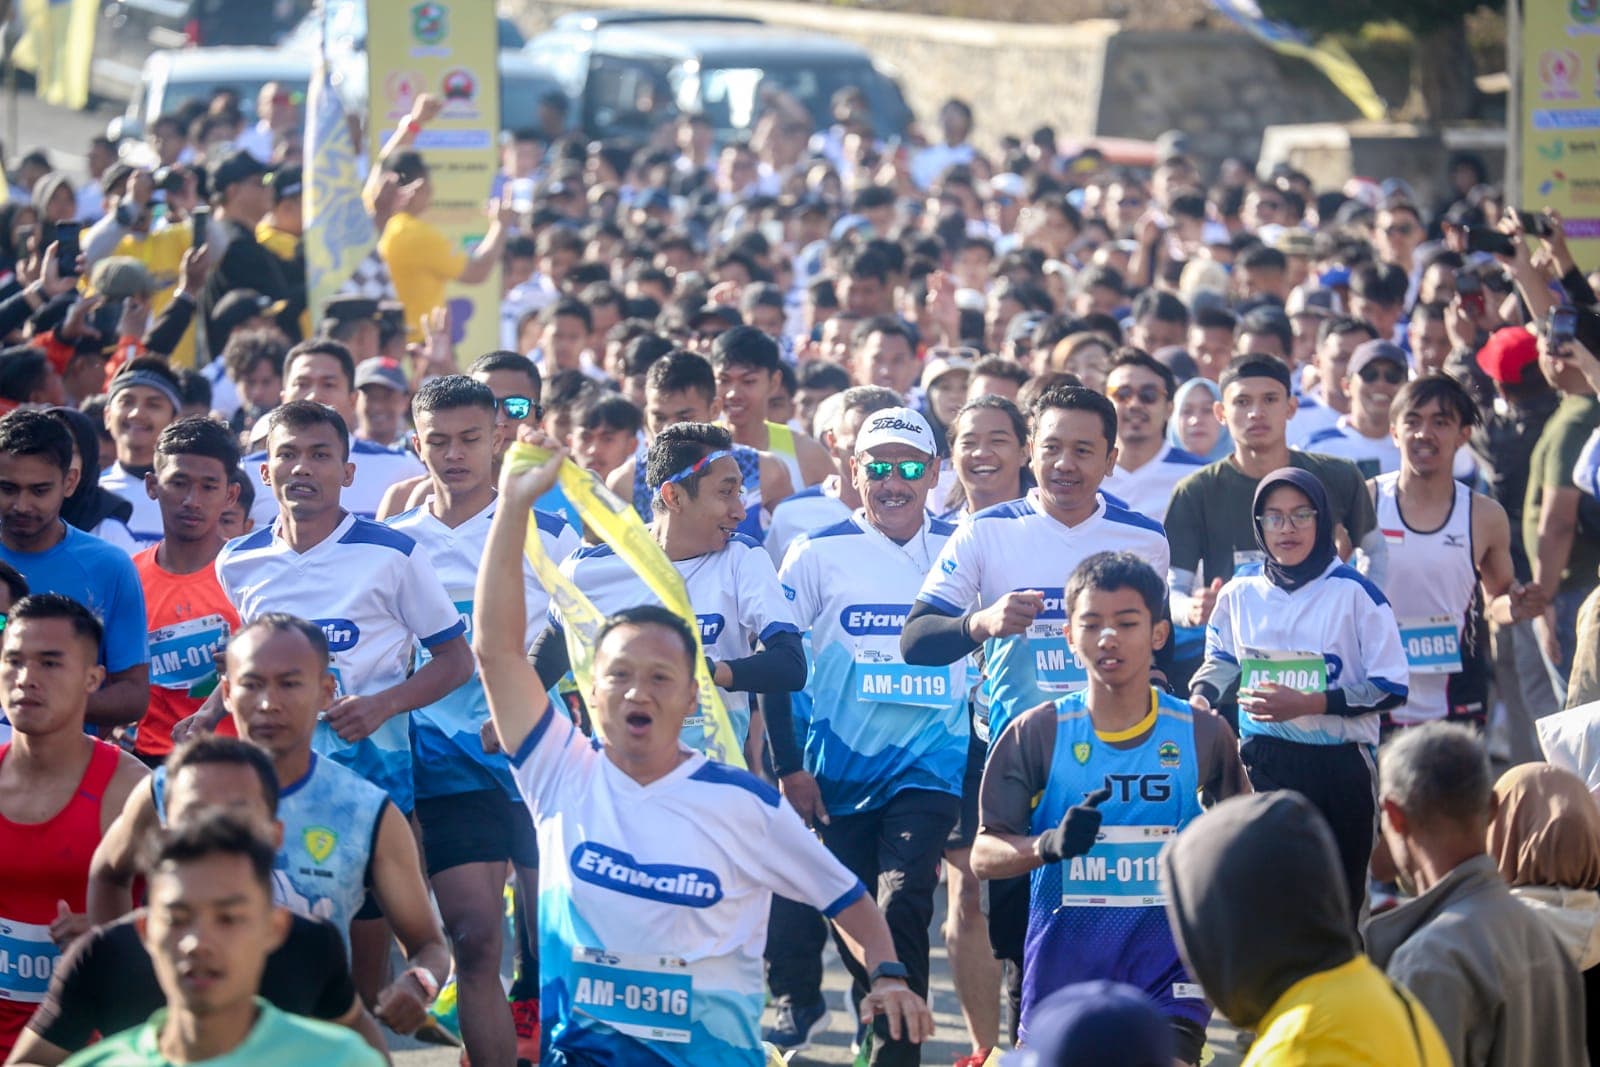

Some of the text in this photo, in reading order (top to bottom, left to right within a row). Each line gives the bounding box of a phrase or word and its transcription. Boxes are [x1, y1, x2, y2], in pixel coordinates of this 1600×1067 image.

[862, 673, 946, 697] AM-0119
[577, 848, 717, 900] Etawalin
[574, 976, 688, 1017] AM-0316
